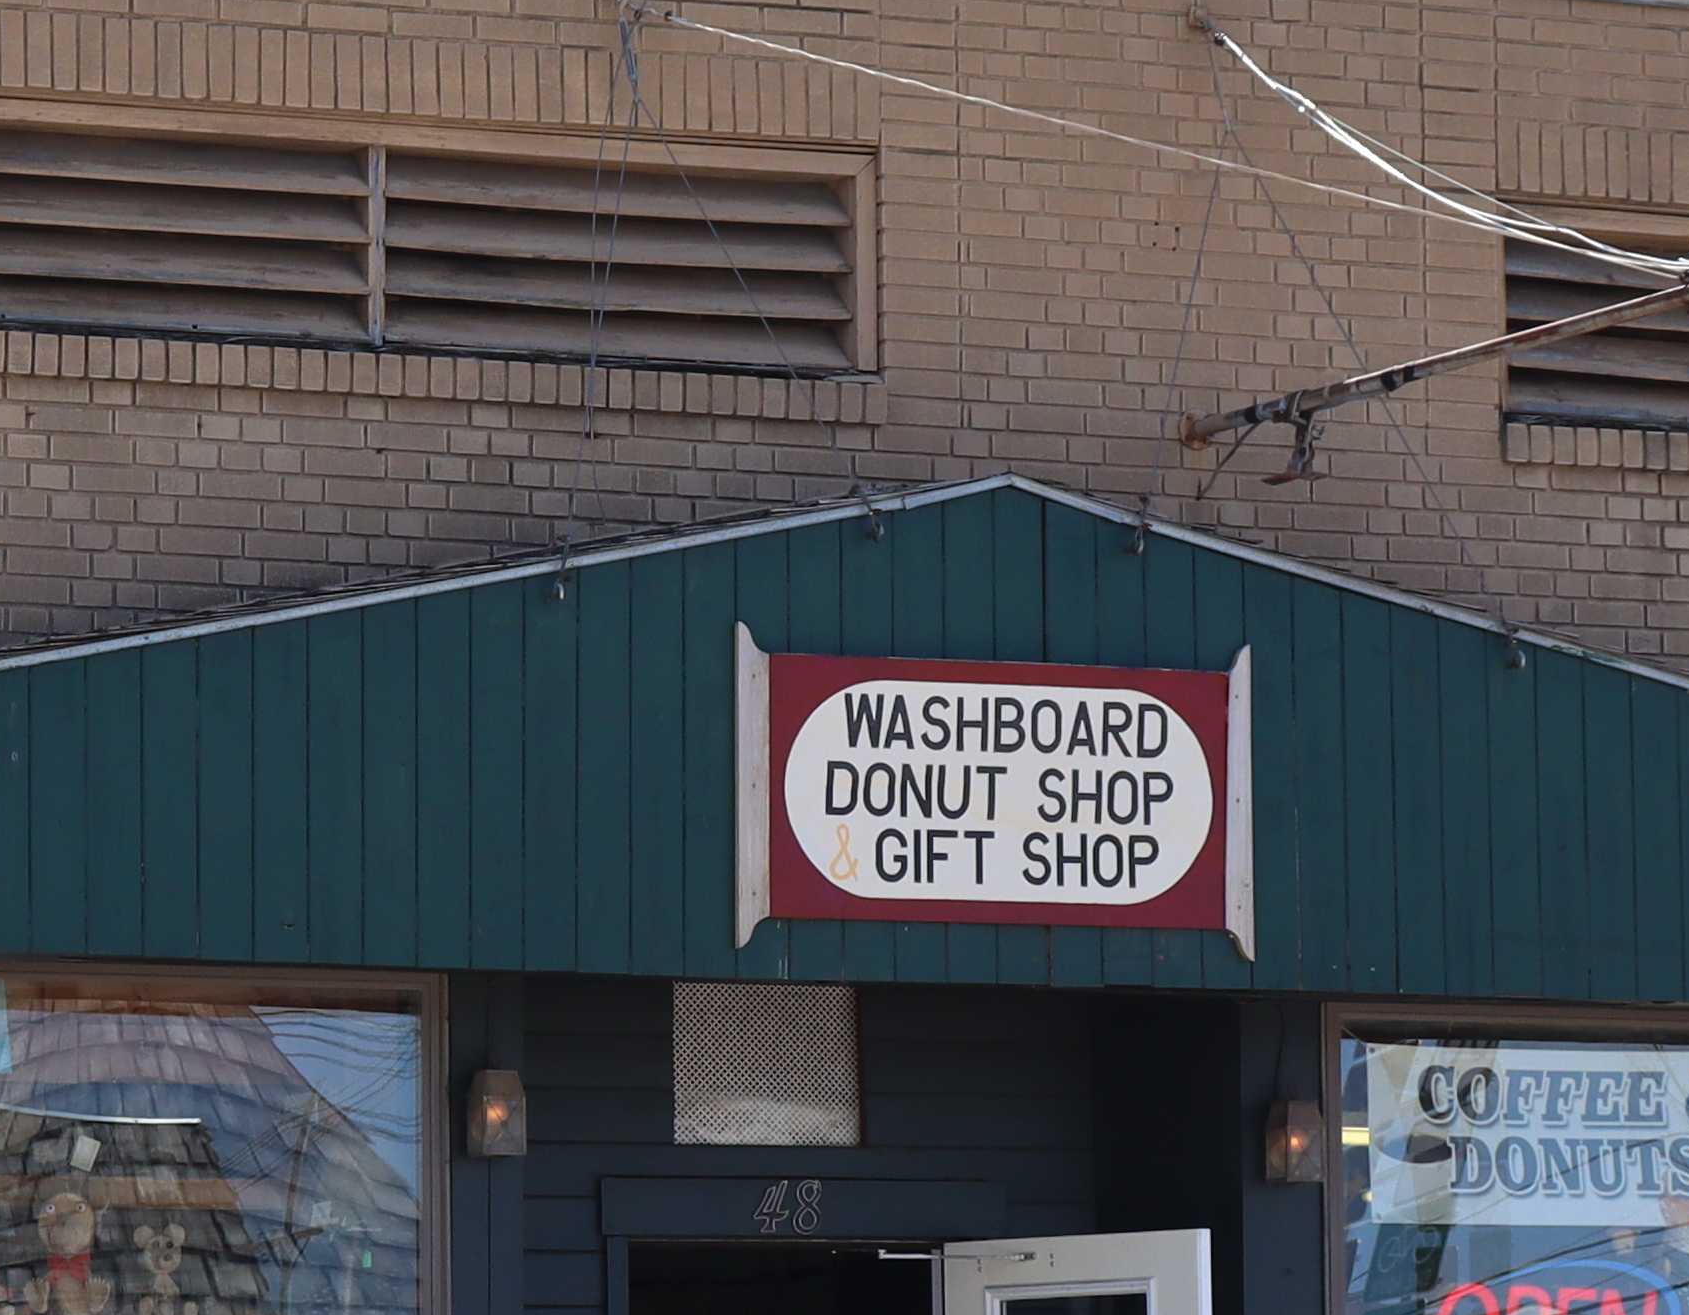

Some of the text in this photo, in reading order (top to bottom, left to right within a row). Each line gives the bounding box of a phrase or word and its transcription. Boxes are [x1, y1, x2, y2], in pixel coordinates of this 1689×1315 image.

[844, 692, 1168, 758] WASHBOARD
[825, 761, 1174, 826] DONUT SHOP
[829, 823, 1160, 888] & GIFT SHOP
[1417, 1063, 1668, 1127] COFFEE
[753, 1179, 823, 1236] 48
